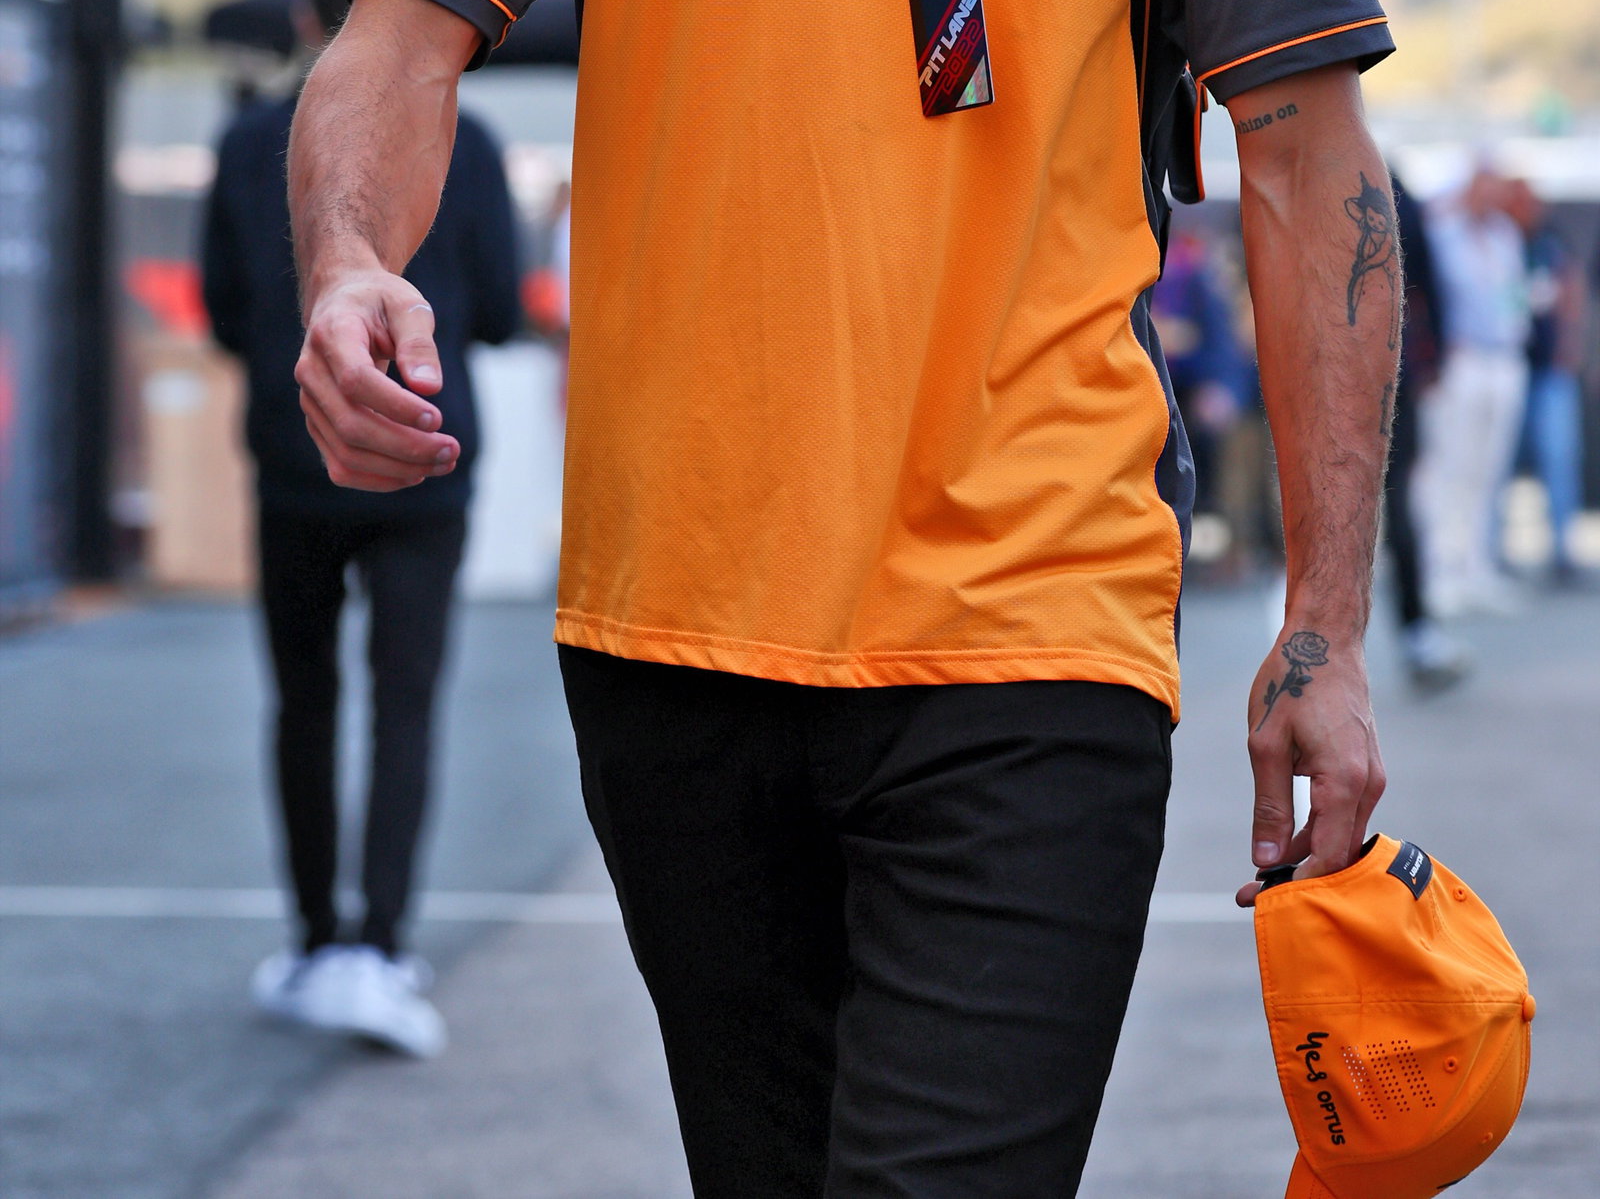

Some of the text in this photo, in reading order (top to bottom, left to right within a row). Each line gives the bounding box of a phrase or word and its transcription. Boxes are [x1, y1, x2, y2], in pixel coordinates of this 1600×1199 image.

[919, 45, 946, 87] PIT
[1276, 104, 1298, 119] on
[1317, 1091, 1346, 1145] OPTUS
